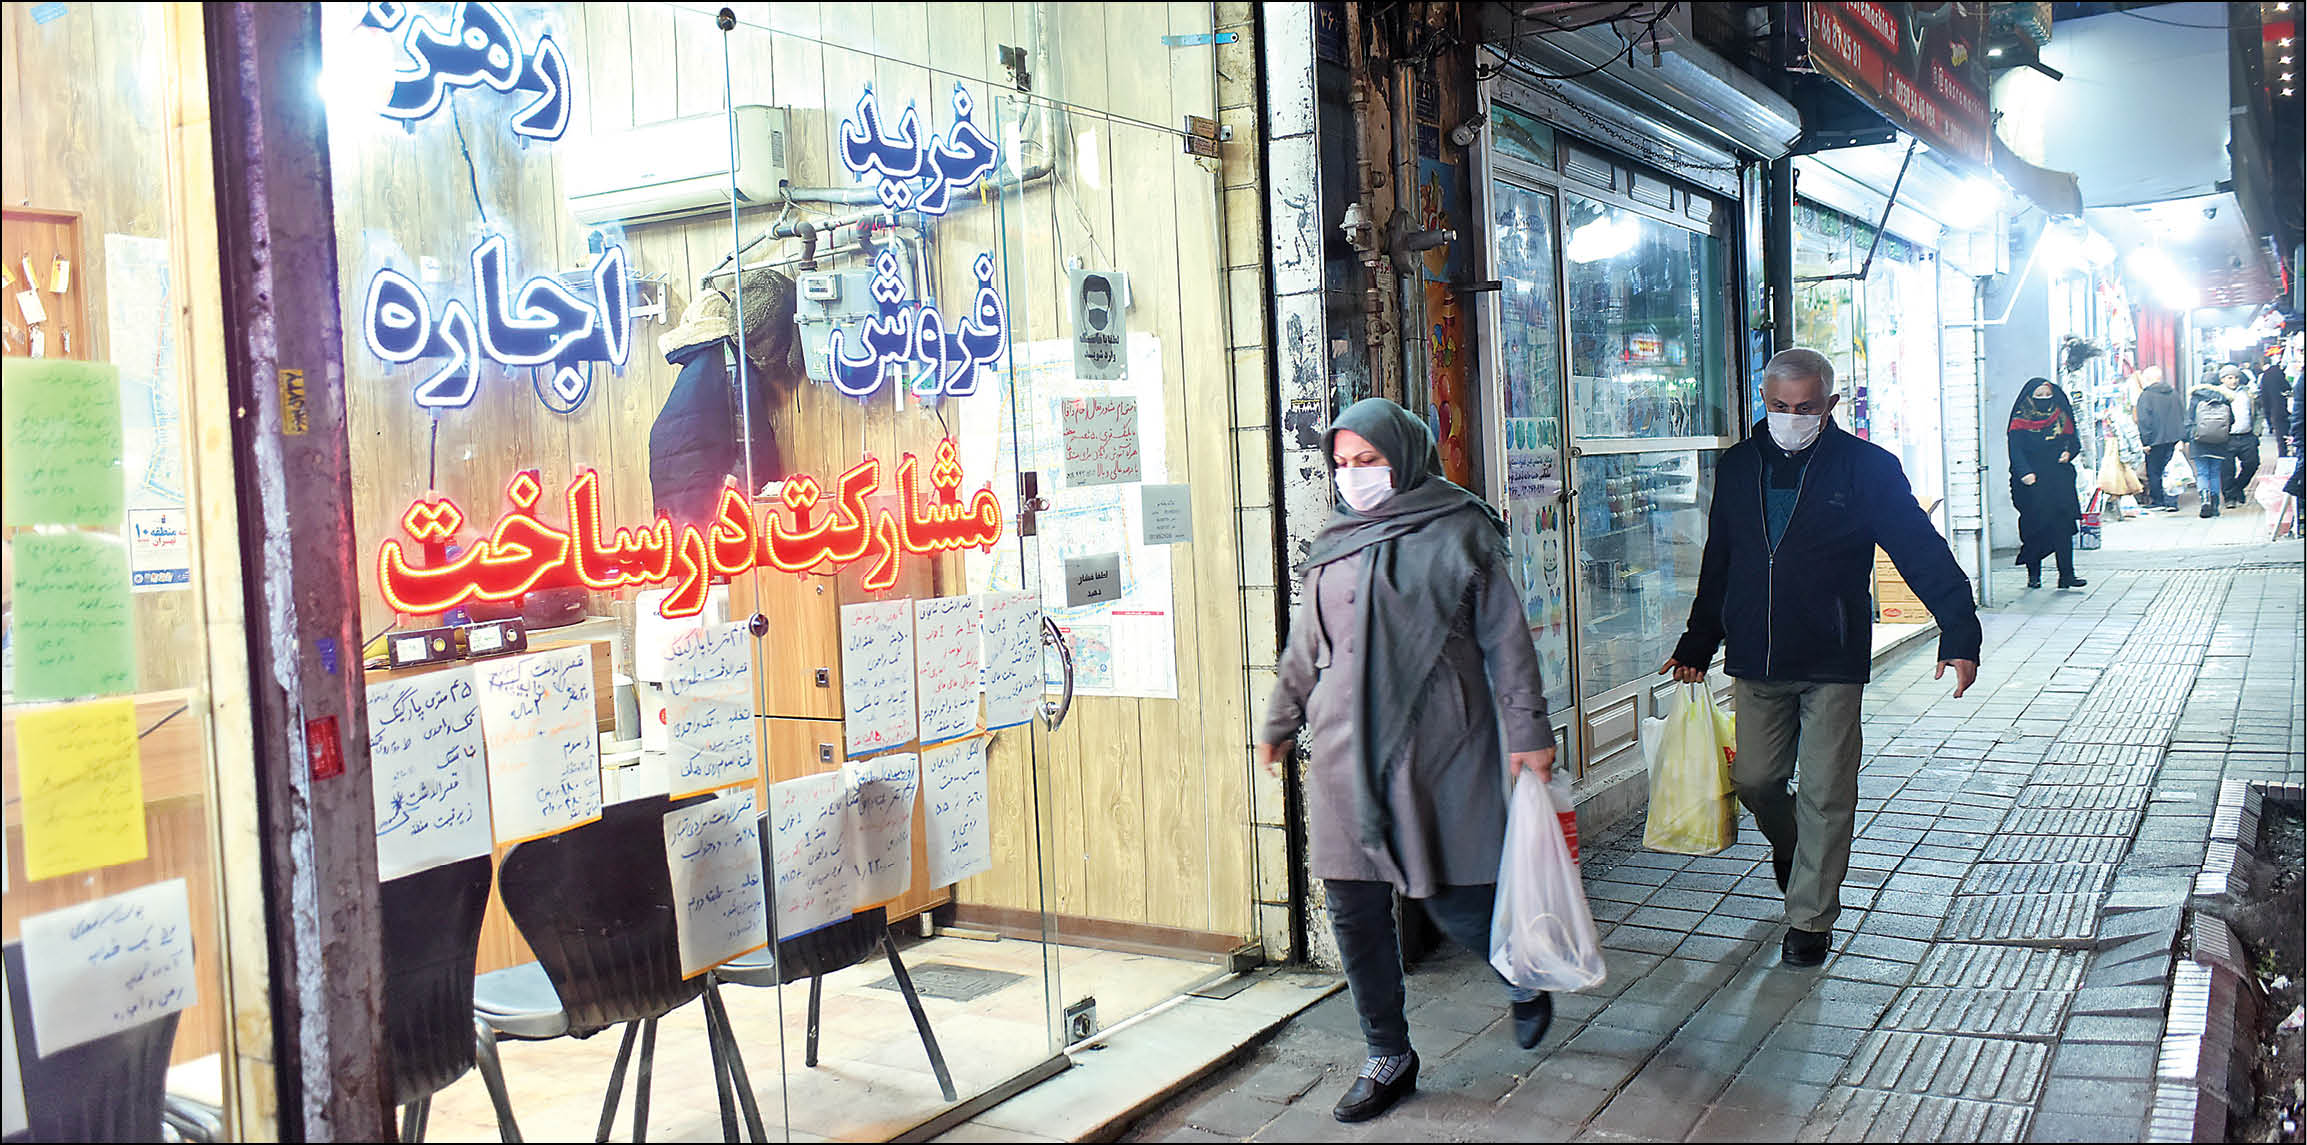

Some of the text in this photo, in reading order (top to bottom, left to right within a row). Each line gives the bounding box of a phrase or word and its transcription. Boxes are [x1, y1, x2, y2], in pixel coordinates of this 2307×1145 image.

[840, 85, 999, 216] خرید
[365, 235, 629, 408] اجاره
[828, 250, 1007, 396] فروش
[151, 525, 177, 538] منطقه
[378, 438, 1003, 618] مشارکت در ساخت
